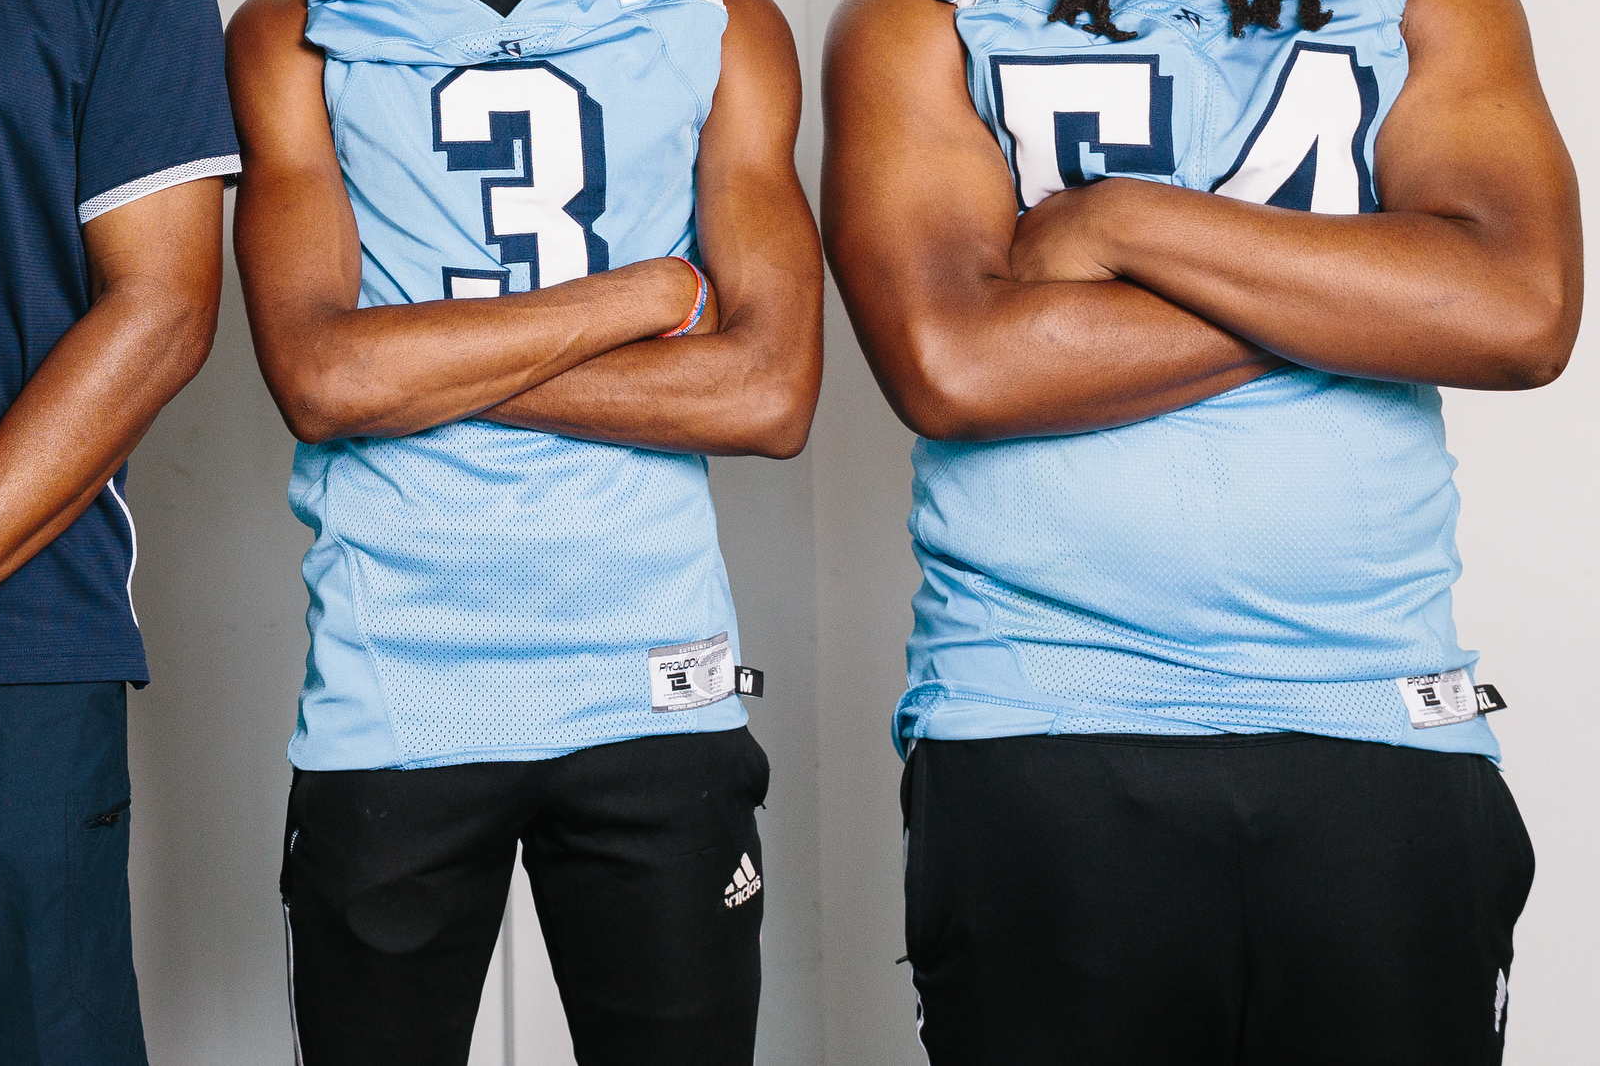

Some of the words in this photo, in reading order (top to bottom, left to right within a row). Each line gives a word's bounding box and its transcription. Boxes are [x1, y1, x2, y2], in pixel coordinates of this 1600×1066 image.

[430, 59, 607, 301] 3
[678, 641, 713, 654] AUTHENTIC
[739, 672, 754, 694] M
[1475, 691, 1498, 711] XL
